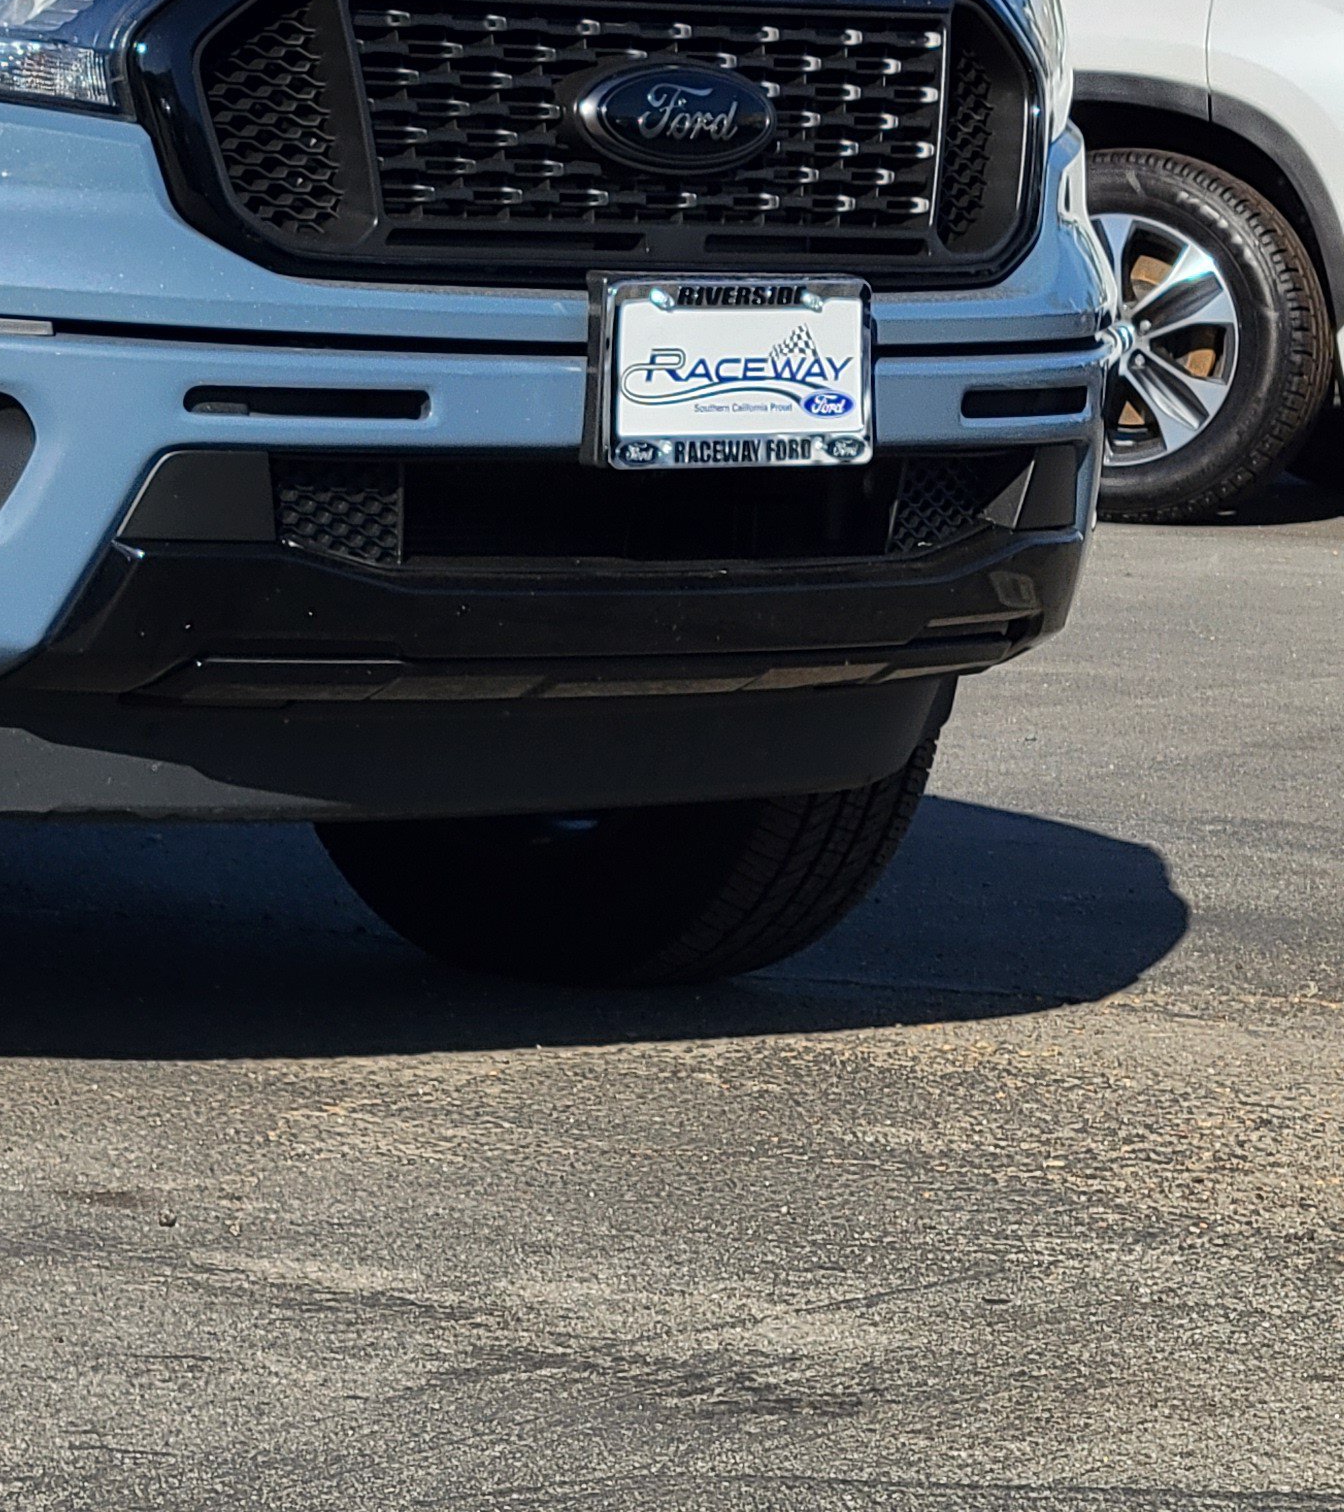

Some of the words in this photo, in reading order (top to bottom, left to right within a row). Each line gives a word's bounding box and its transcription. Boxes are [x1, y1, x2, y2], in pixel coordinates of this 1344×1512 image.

[638, 83, 739, 141] Ford
[644, 348, 854, 383] RACEWAY
[694, 403, 730, 413] Southern
[732, 402, 769, 412] California
[770, 402, 793, 412] Proud
[810, 393, 845, 414] Ford
[674, 439, 761, 464] RACEWAY
[766, 438, 813, 462] FORD
